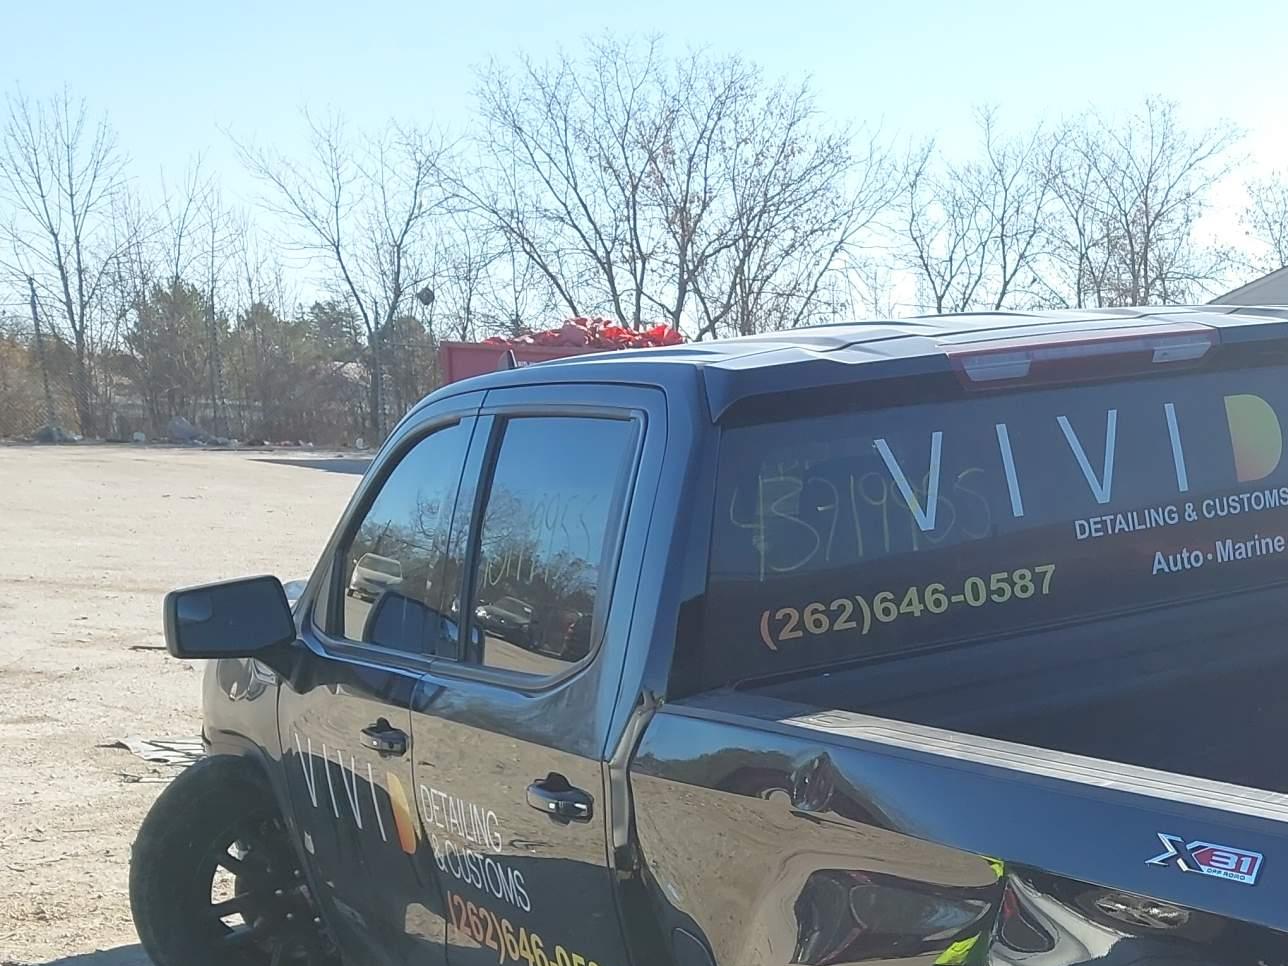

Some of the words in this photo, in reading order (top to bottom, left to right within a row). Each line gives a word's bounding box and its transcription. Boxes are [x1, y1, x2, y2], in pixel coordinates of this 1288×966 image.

[874, 394, 1283, 531] VIVID
[1075, 504, 1180, 540] DETAILING
[1184, 500, 1198, 523] &
[759, 563, 1057, 651] (262)646-0587
[419, 784, 503, 852] DETAILING
[431, 834, 449, 872] &
[446, 844, 531, 911] CUSTOMS
